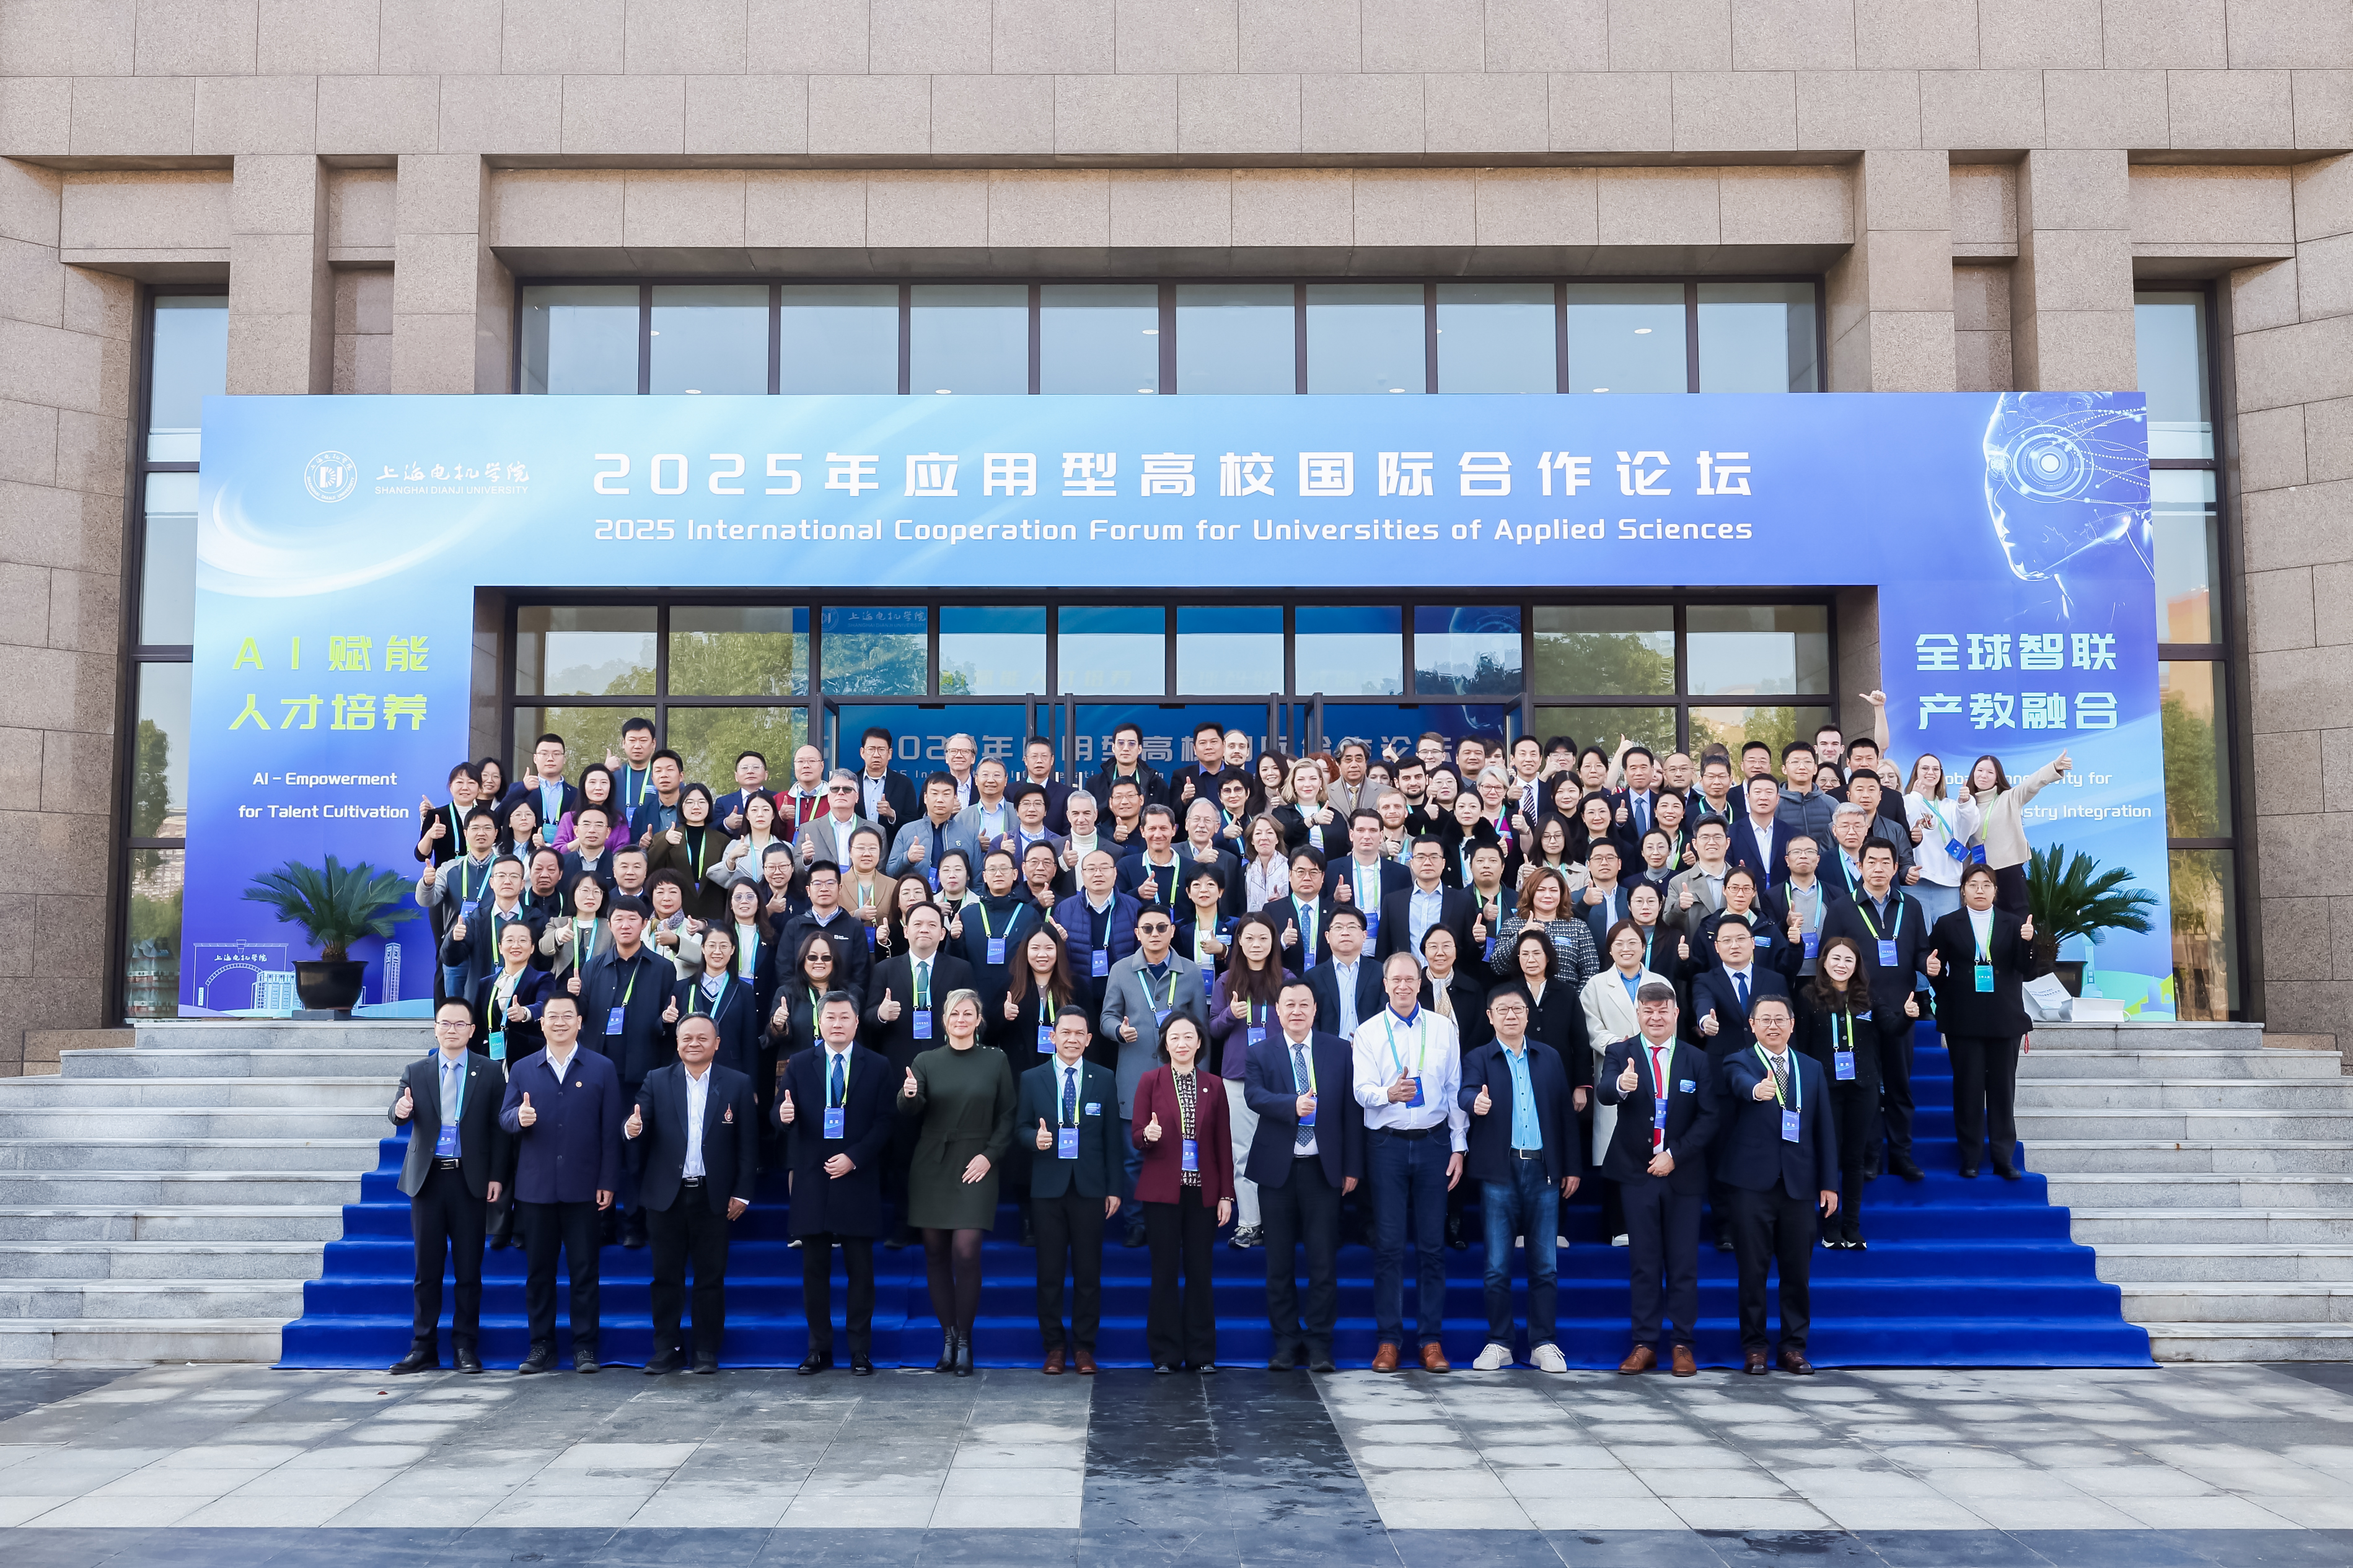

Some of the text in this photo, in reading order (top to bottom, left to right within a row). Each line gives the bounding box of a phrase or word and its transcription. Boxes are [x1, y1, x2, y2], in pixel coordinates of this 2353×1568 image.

[376, 460, 529, 483] 上海电机学院
[593, 451, 1753, 497] 2025年应用型高校国际合作论坛
[374, 486, 529, 494] SHANGHAI DIANJI UNIVERSITY
[594, 519, 1753, 545] 2025 International Cooperation Forum for Universities of Applied Sciences
[232, 636, 429, 672] AI赋能
[1915, 633, 2117, 671] 全球智联
[229, 694, 428, 730] 人才培养
[1918, 692, 2118, 730] 产教融合
[252, 772, 268, 785] AI
[285, 772, 397, 788] Empowerment
[2088, 771, 2113, 784] for
[238, 805, 409, 818] for Talent Cultivation
[2064, 805, 2152, 821] Integration
[214, 953, 267, 962] 上海电机学院
